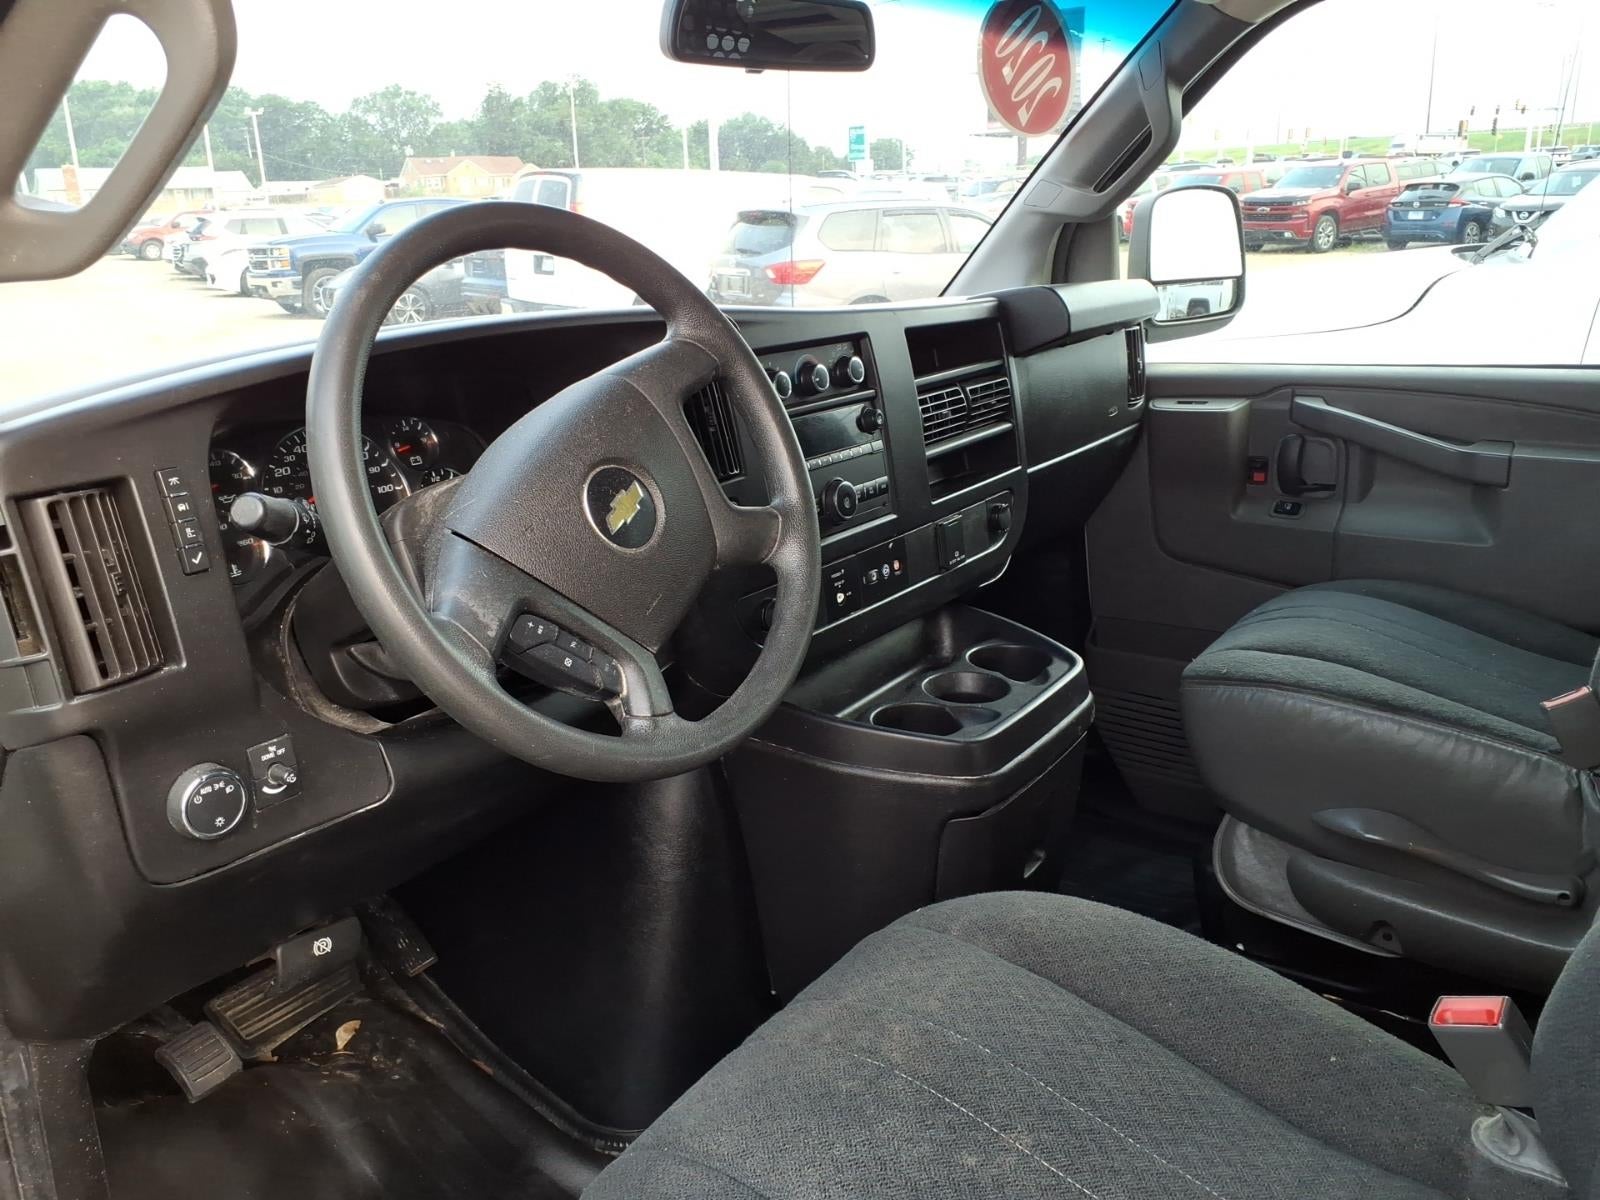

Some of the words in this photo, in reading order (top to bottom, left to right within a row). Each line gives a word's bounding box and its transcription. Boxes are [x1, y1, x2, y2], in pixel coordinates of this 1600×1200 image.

[283, 454, 296, 463] 30
[274, 466, 291, 477] 20
[368, 466, 381, 474] 90
[273, 486, 283, 494] 10
[377, 483, 394, 494] 100
